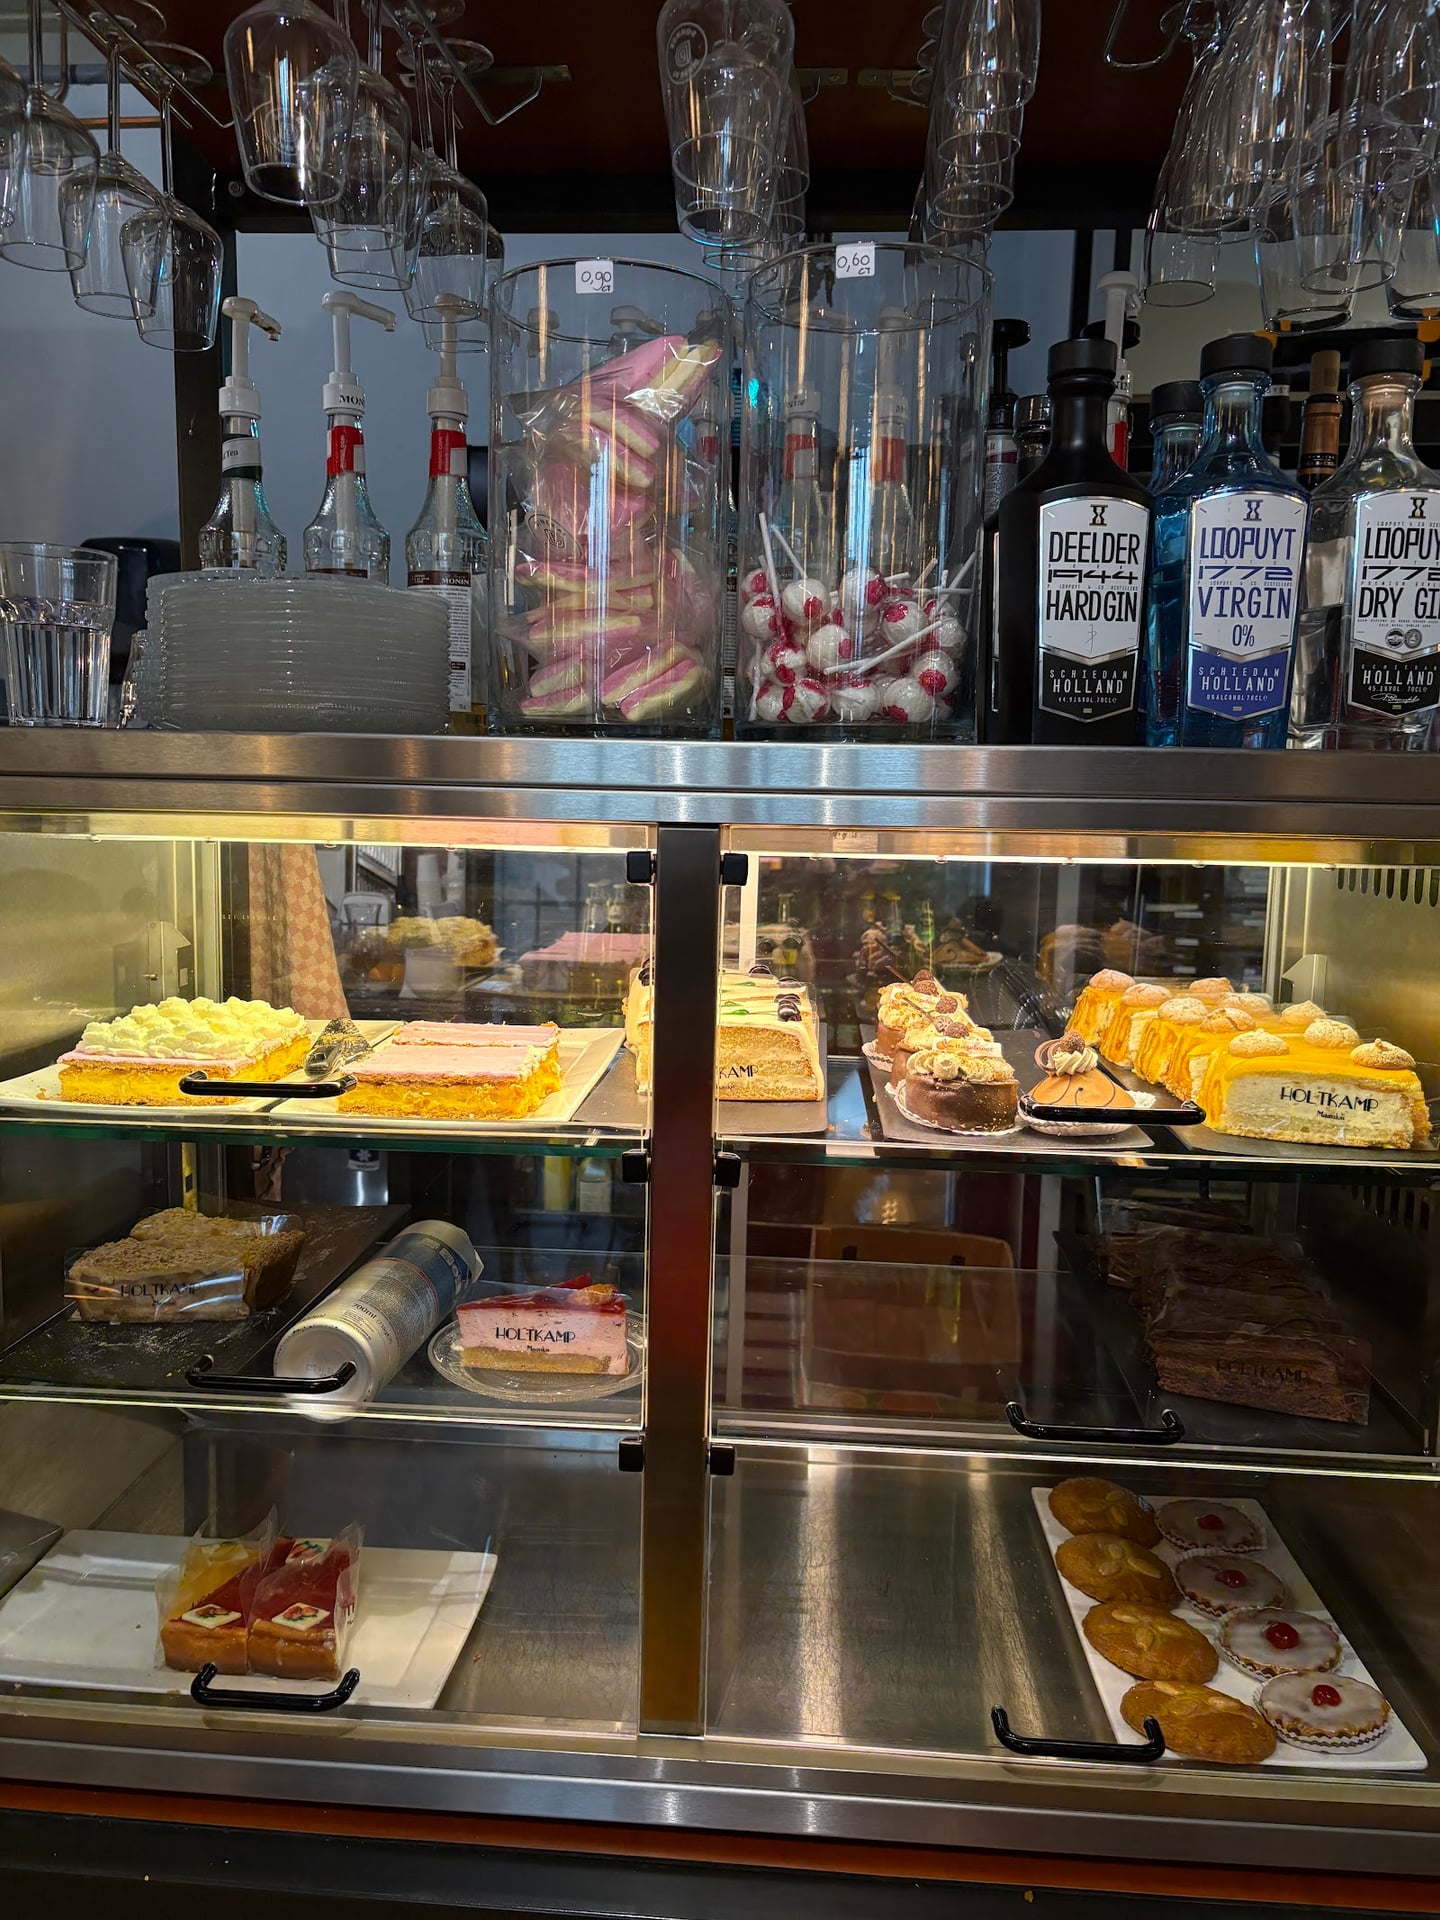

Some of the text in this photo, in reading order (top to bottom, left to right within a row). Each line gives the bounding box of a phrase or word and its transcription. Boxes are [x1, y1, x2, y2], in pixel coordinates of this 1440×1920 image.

[836, 252, 871, 273] 0,60
[581, 270, 612, 291] 0,90
[1048, 530, 1140, 565] DEELDER
[1200, 526, 1297, 560] LOOPUYT
[441, 577, 470, 586] MONIN
[1198, 565, 1294, 581] 1772
[1197, 586, 1292, 619] VIRGIN
[1358, 586, 1440, 620] DRY GI
[1232, 624, 1255, 647] 0%
[1049, 669, 1128, 680] SCHIEDAM
[1198, 666, 1280, 678] SCHIEDAM
[1362, 669, 1434, 687] HOLLAND
[1052, 678, 1124, 694] HOLLAND
[1201, 676, 1275, 692] HOLLAND
[1280, 1086, 1380, 1113] HOLTKAMP
[351, 1302, 377, 1319] 700ml
[495, 1326, 577, 1344] HOLTKAMP
